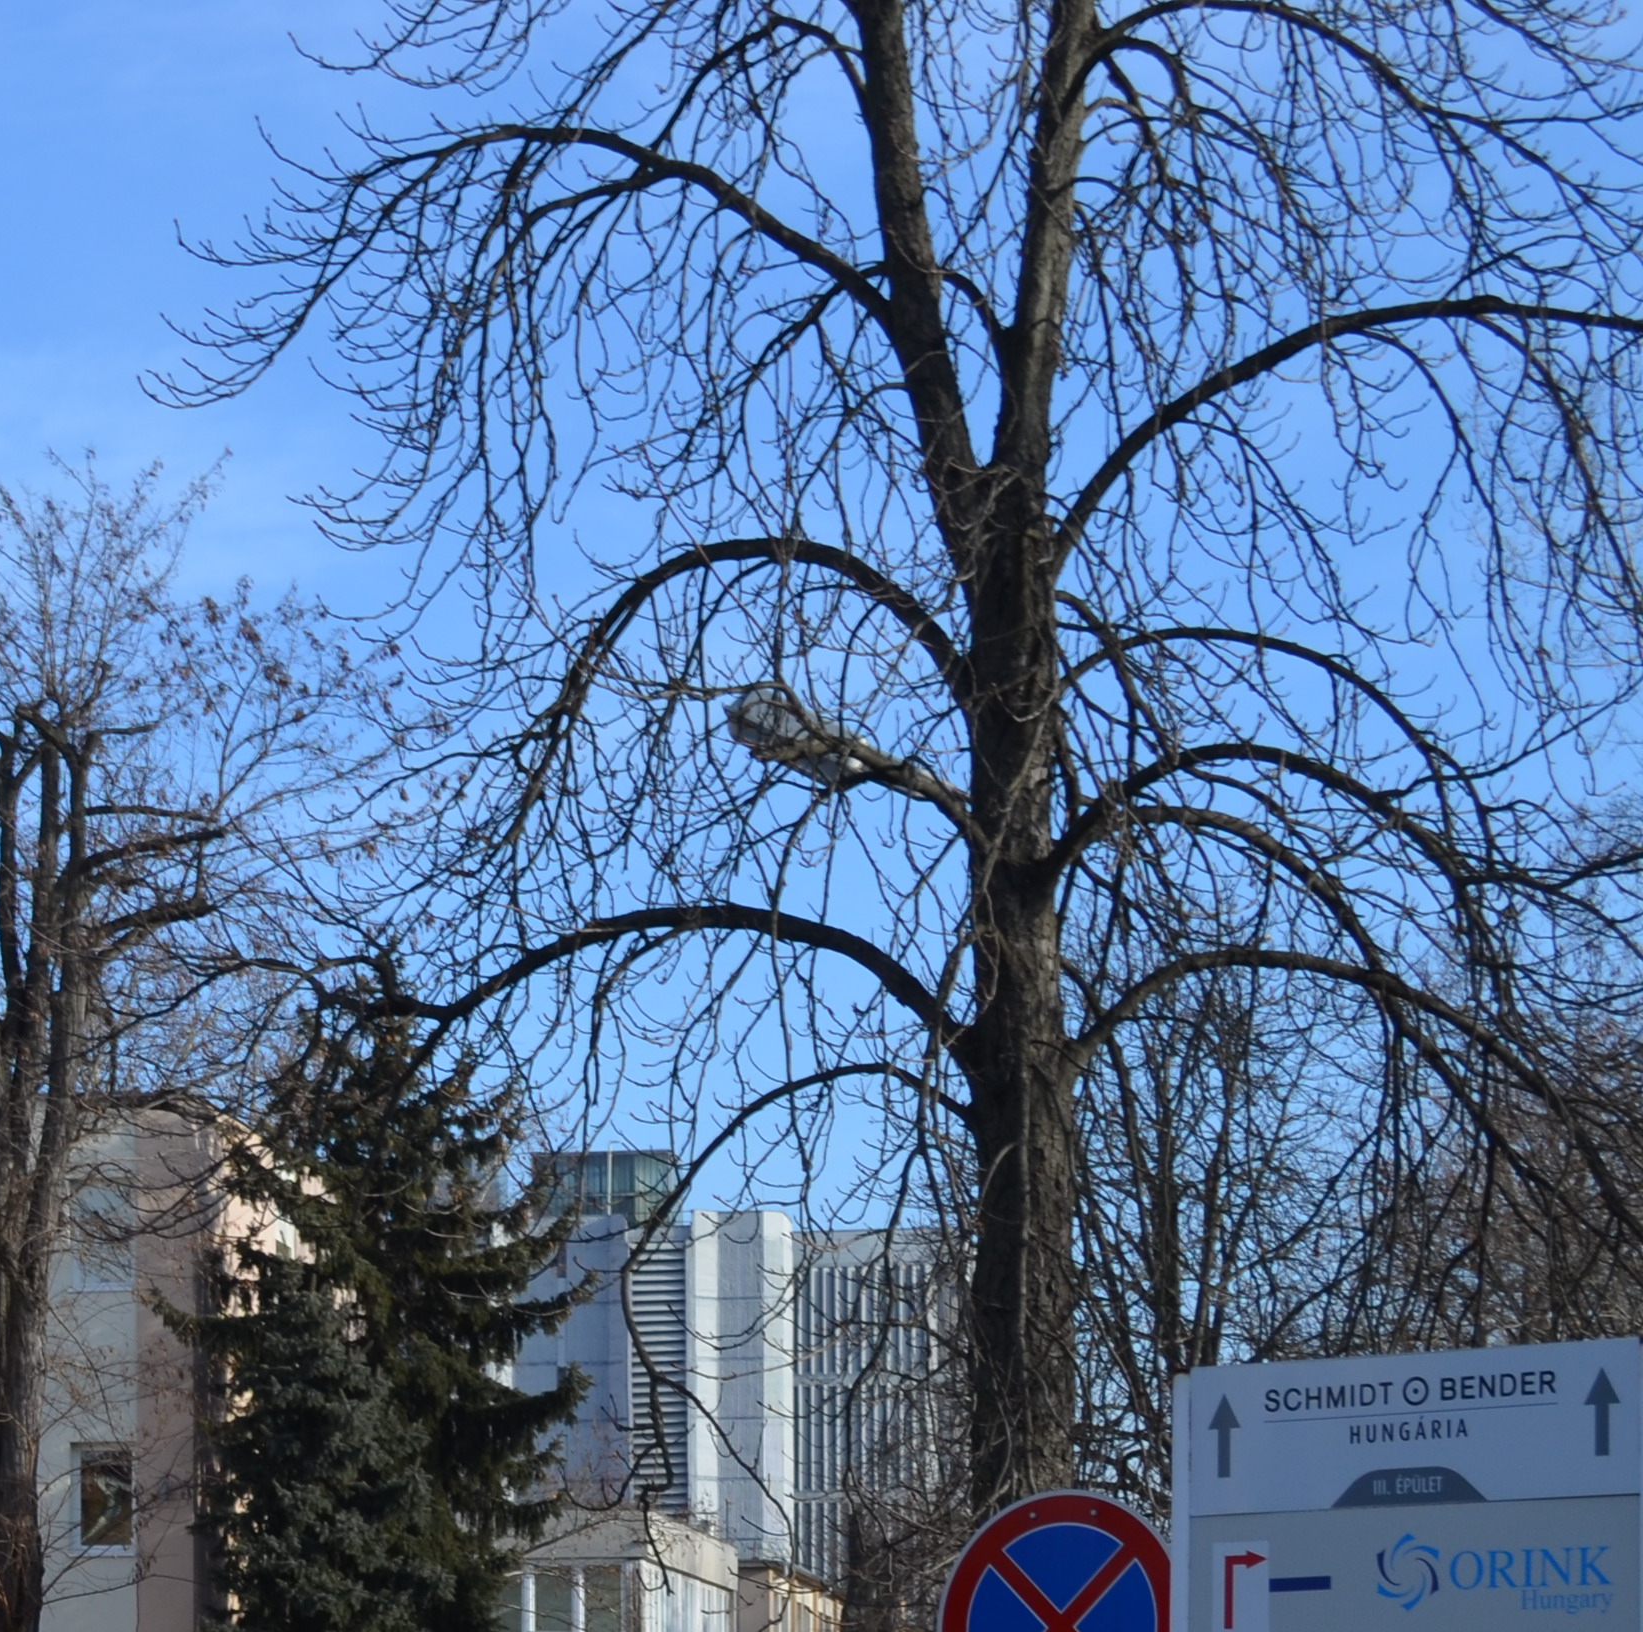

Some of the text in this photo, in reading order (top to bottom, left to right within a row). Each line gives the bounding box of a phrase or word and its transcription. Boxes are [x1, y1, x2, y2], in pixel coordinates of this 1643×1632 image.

[1264, 1370, 1557, 1413] SCHMIDT BENDER
[1349, 1417, 1469, 1445] HUNGÁRIA
[1372, 1473, 1444, 1496] III. ÉPÜLET
[1449, 1545, 1612, 1591] ORINK
[1521, 1589, 1613, 1615] Hungary
